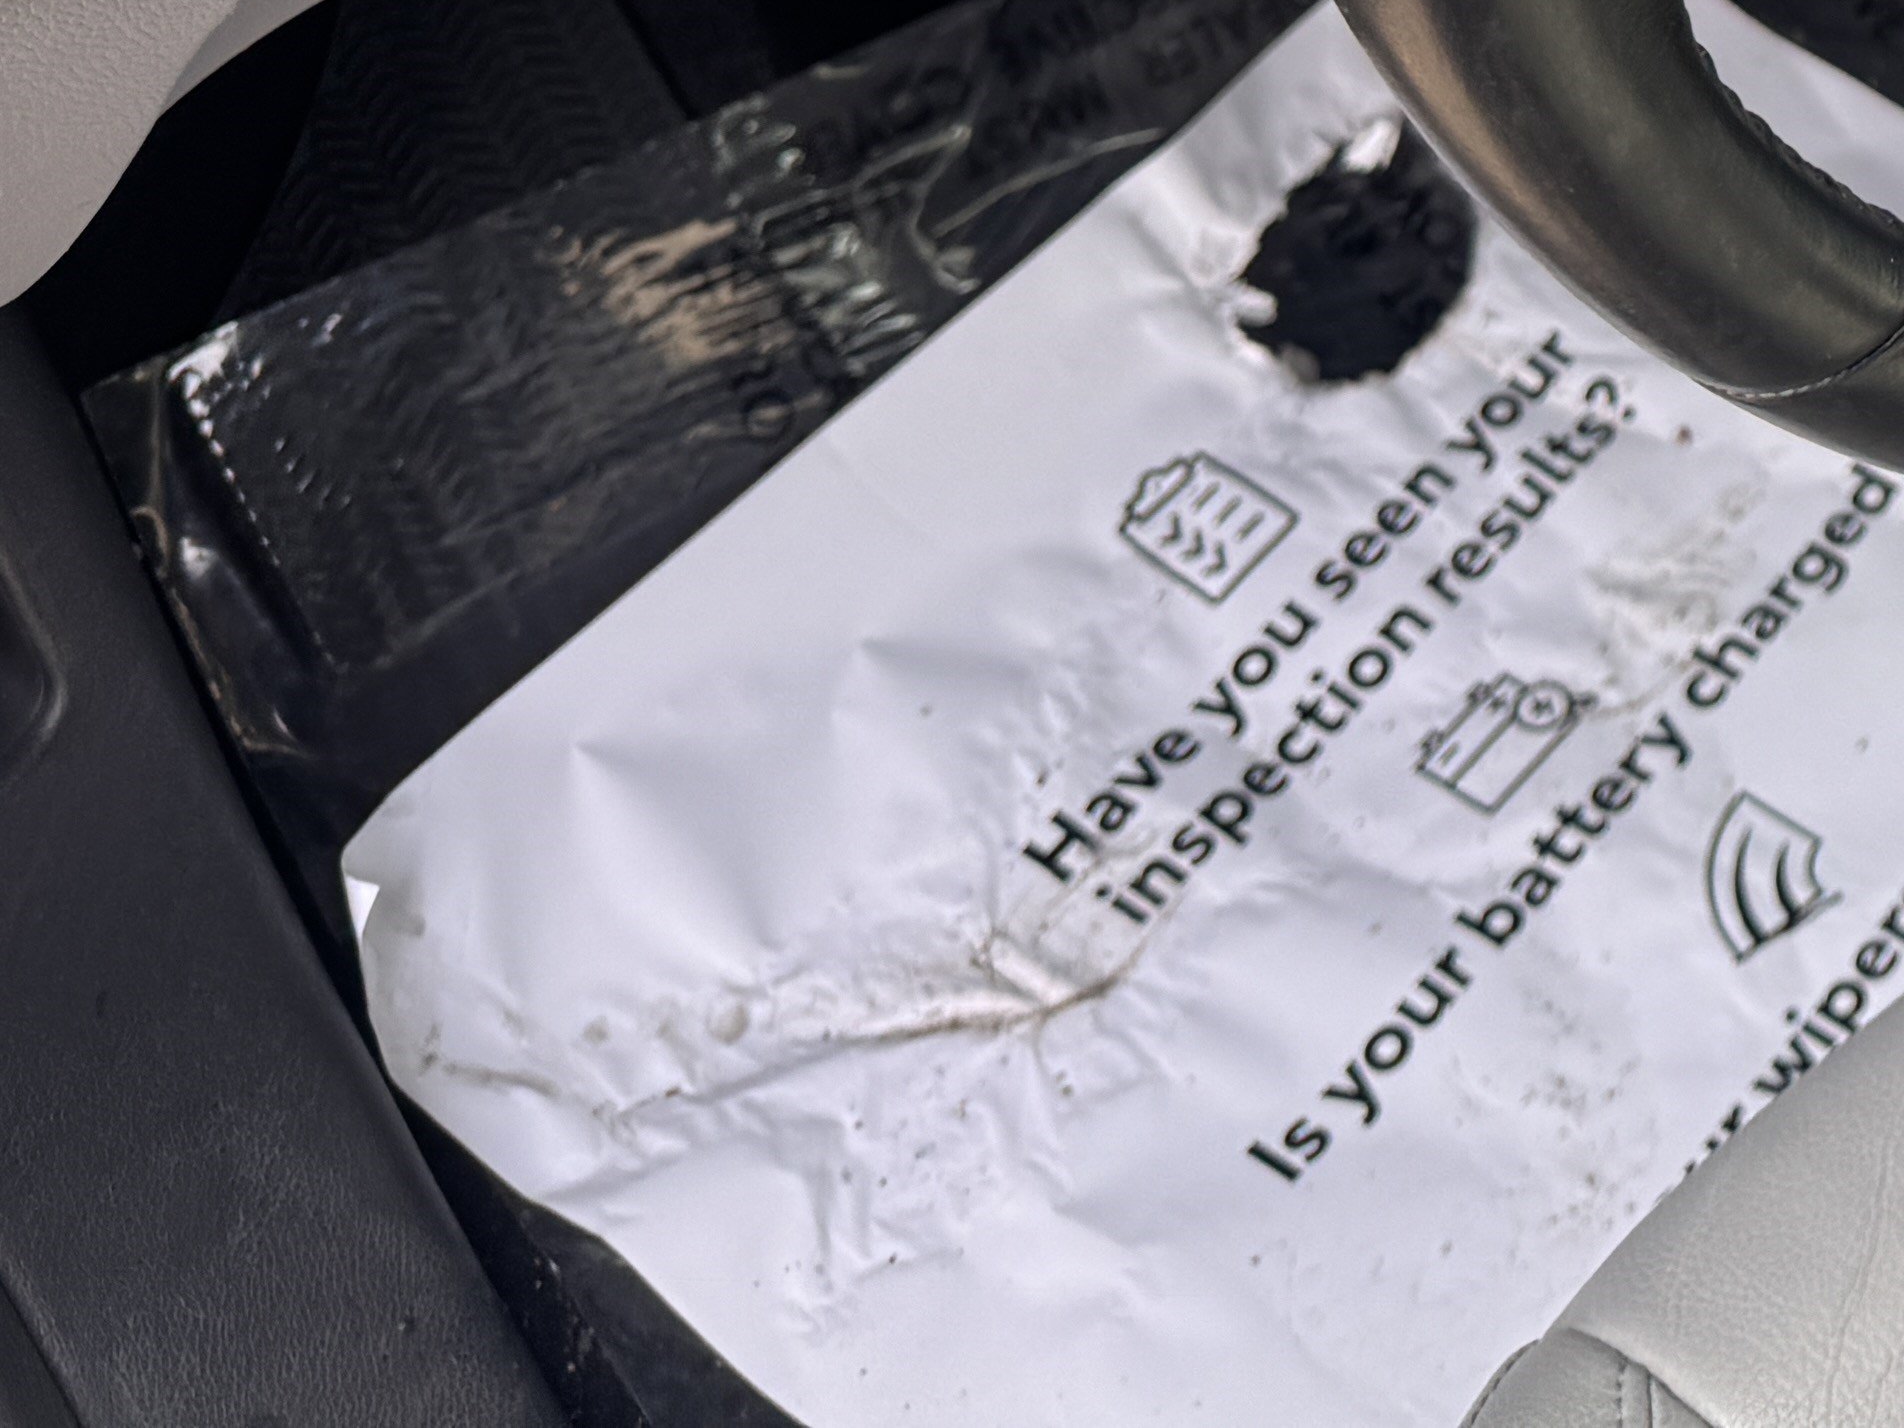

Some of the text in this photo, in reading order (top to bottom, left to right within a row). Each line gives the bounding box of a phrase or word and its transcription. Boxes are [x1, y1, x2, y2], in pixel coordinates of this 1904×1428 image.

[1022, 725, 1200, 885] Have
[1194, 599, 1319, 735] you
[1316, 460, 1456, 603] seen
[1442, 331, 1578, 472] your
[1095, 603, 1434, 928] inspection
[1425, 373, 1640, 606] results?
[1245, 461, 1901, 1186] Is your battery charged
